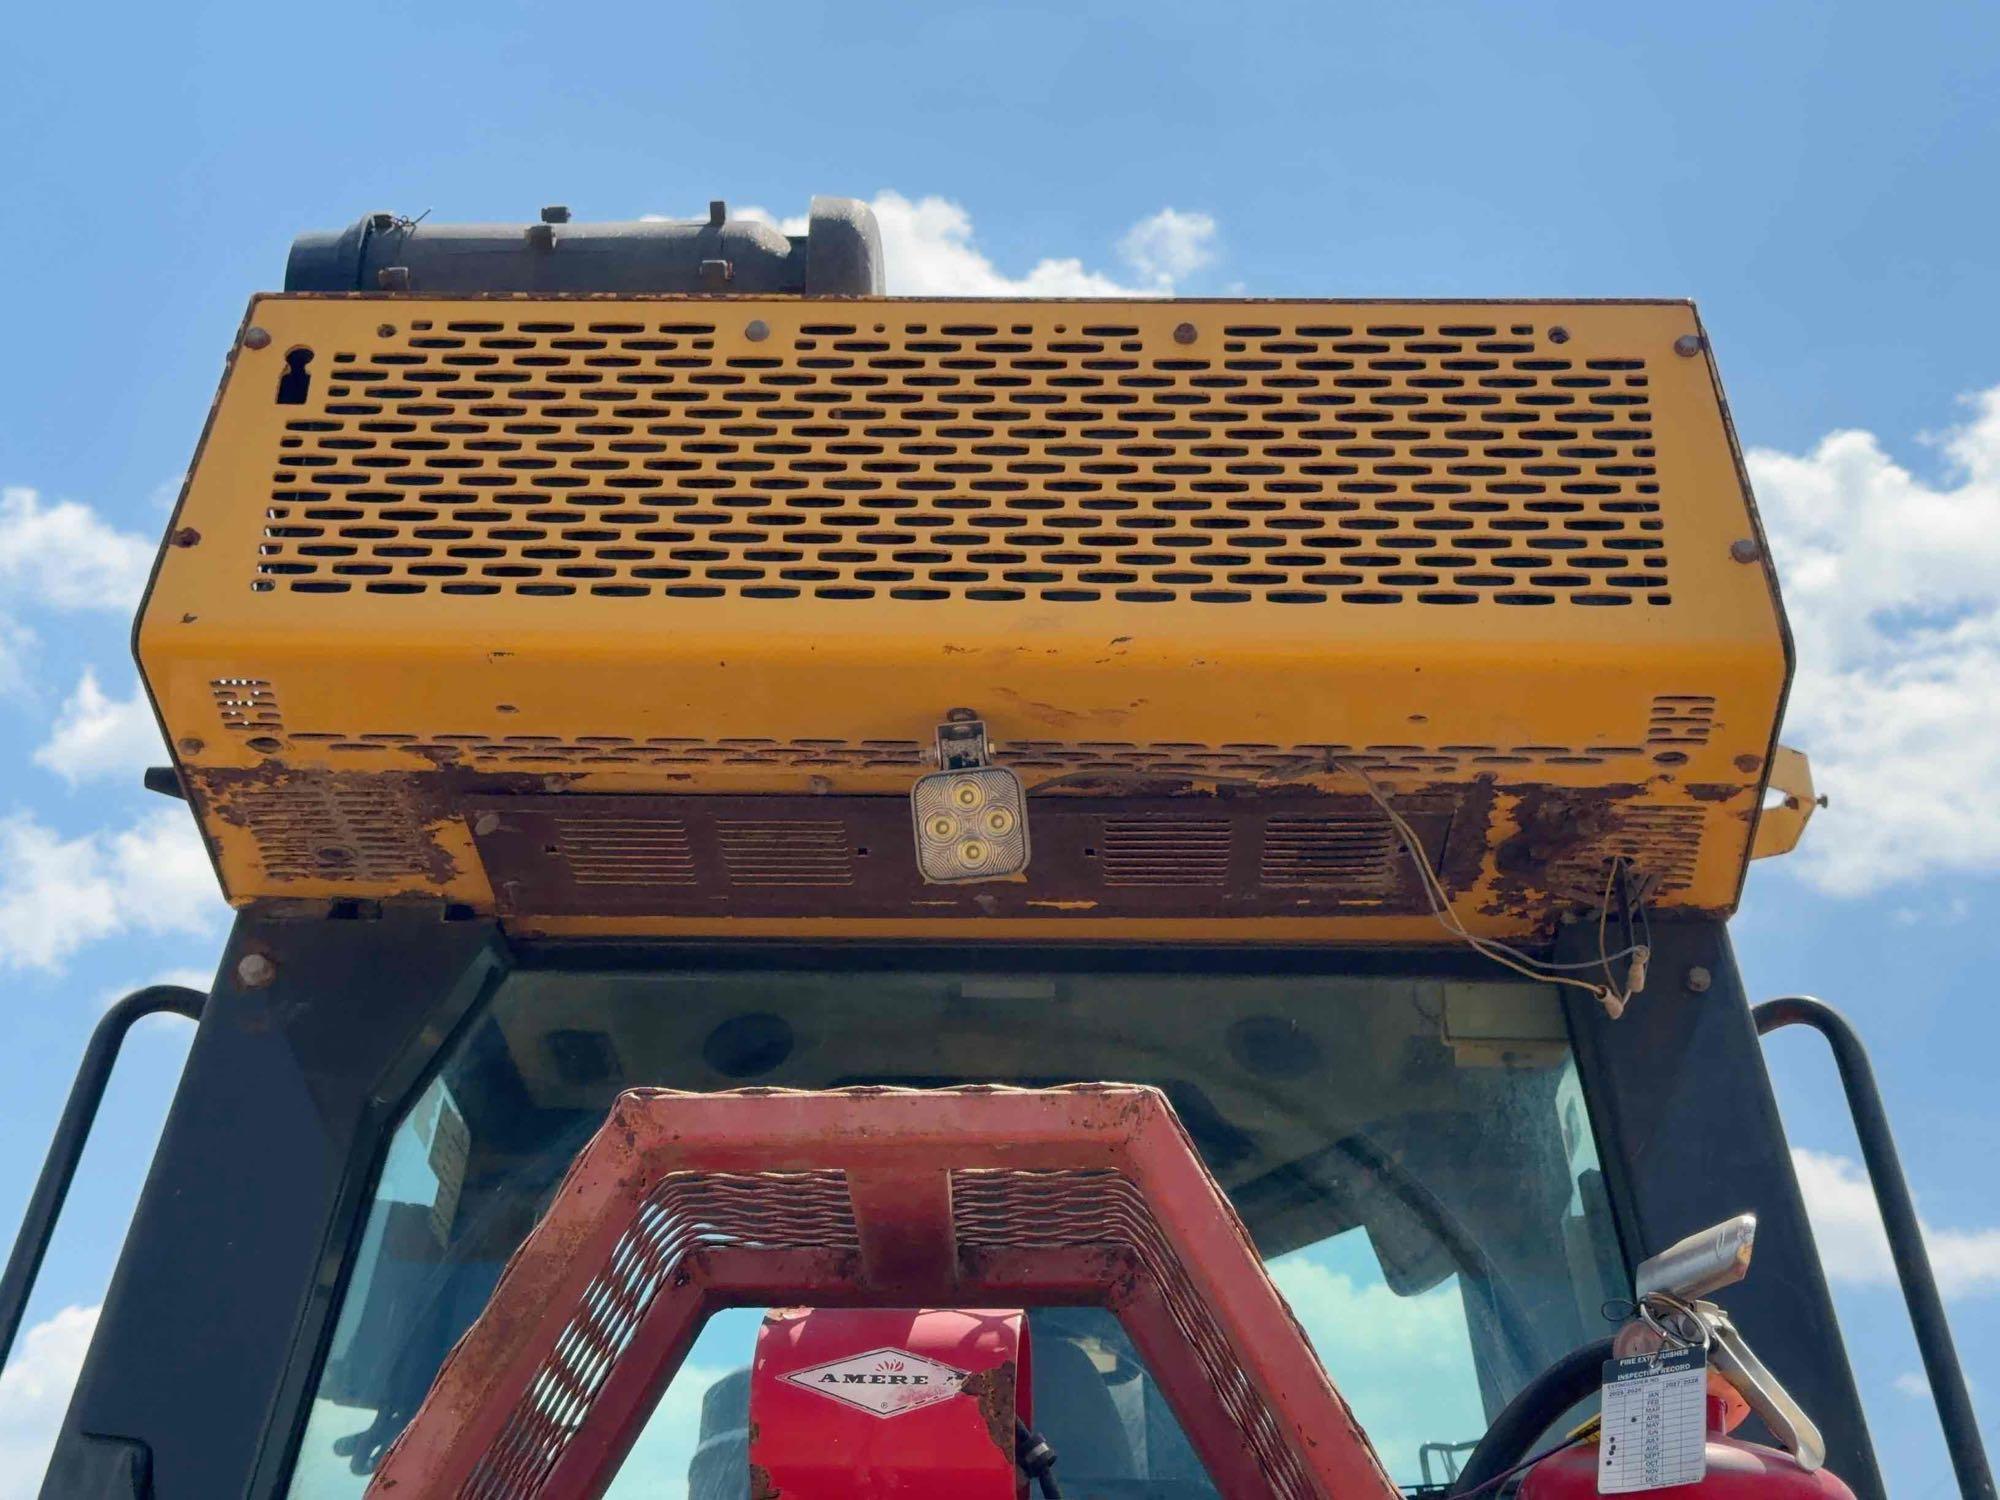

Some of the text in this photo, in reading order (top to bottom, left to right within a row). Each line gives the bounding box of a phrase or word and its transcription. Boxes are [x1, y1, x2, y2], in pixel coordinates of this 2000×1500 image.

[1620, 1349, 1689, 1366] FIRE EXTUISHER
[1662, 1363, 1691, 1374] RECORD
[818, 1373, 954, 1385] AMERE
